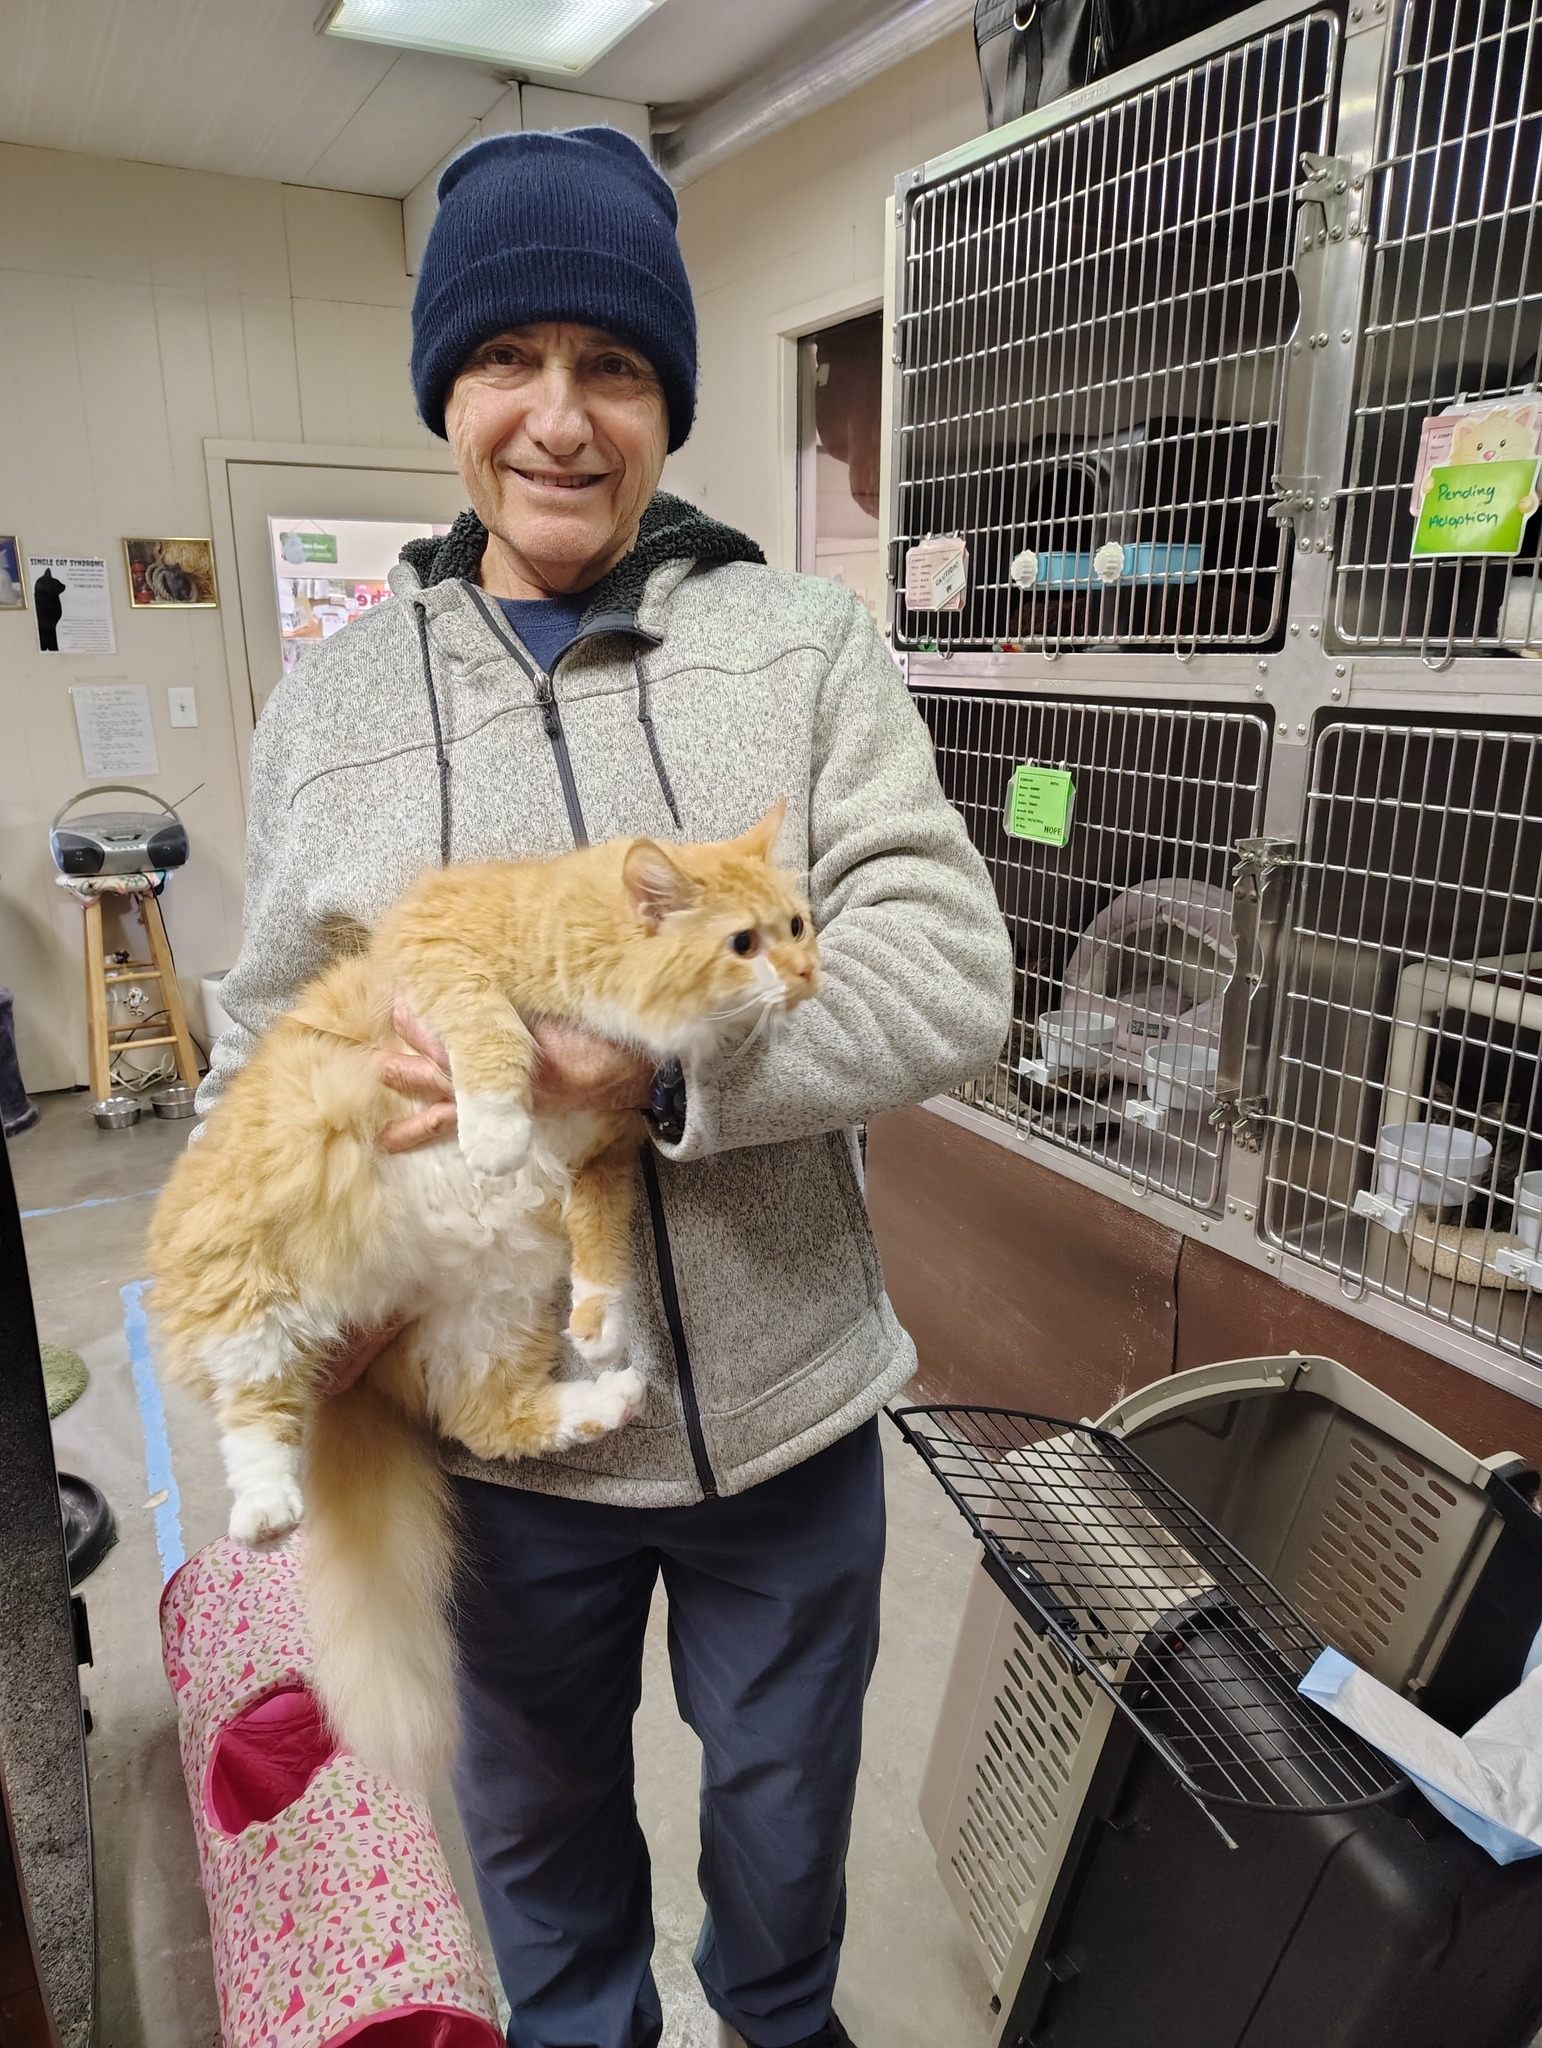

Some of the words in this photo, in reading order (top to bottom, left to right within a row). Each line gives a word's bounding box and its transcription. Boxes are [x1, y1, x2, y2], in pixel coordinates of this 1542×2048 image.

[1438, 483, 1496, 505] Pending
[1428, 511, 1498, 529] Adoption
[30, 558, 53, 566] SINGLE
[70, 559, 104, 568] SYNDROME
[1044, 825, 1061, 836] HOPE
